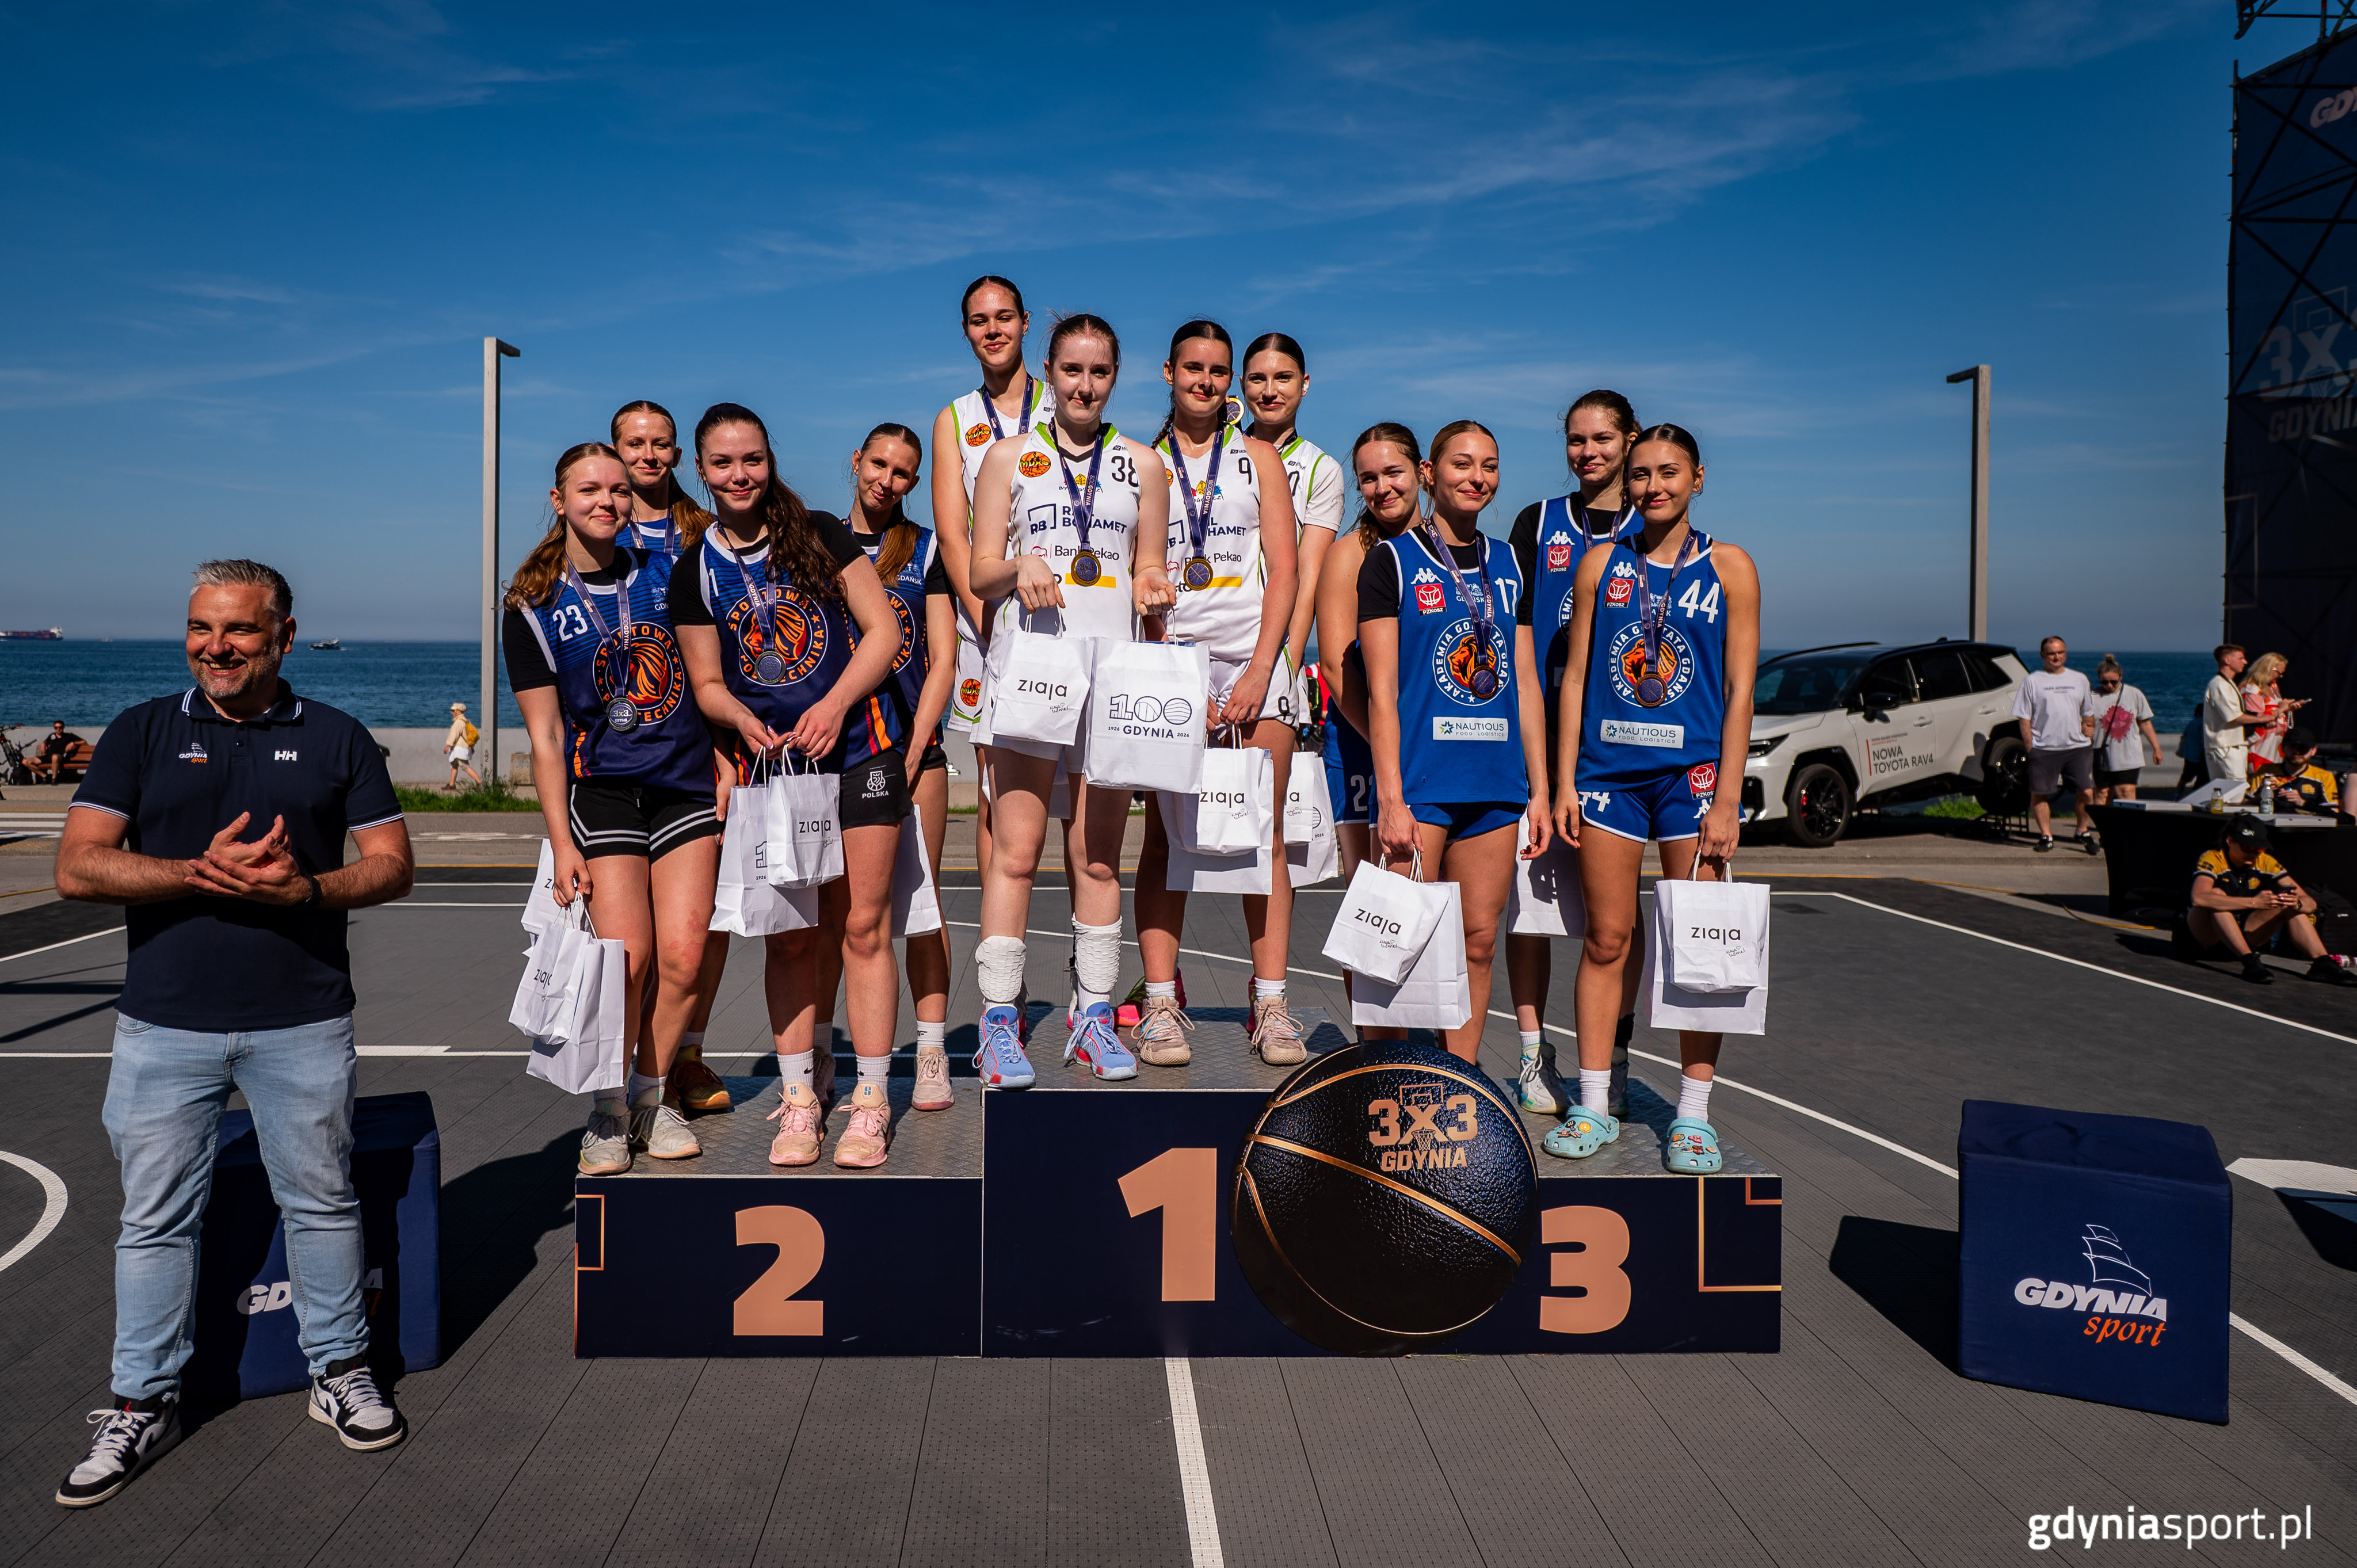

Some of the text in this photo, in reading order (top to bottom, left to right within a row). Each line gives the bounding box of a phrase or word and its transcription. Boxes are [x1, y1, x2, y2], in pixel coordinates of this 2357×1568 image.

[2310, 86, 2357, 128] GD
[1111, 456, 1139, 487] 38
[1238, 457, 1252, 485] 9
[1029, 520, 1047, 535] RB
[1214, 551, 1242, 563] Pekao
[1494, 577, 1518, 617] 17
[1678, 579, 1720, 624] 44
[552, 605, 589, 642] 23
[1436, 633, 1460, 697] AKADEMIA
[1610, 633, 1632, 697] AKADEMIA
[1017, 679, 1067, 700] ziaja
[1109, 693, 1192, 725] 100
[1123, 725, 1174, 739] GDYNIA
[274, 750, 298, 761] HH
[1872, 745, 1903, 761] NOWA
[1874, 753, 1933, 775] TOYOTA RAV4
[861, 790, 889, 799] POLSKA
[1200, 792, 1245, 808] ziaja
[799, 819, 831, 837] ziaja
[1354, 908, 1402, 935] ziaja
[1691, 926, 1741, 945] ziaja
[1369, 1094, 1478, 1147] 3X3
[1381, 1146, 1467, 1173] GDYNIA
[1117, 1147, 1217, 1302] 1
[734, 1205, 825, 1336] 2
[1539, 1205, 1631, 1334] 3
[2015, 1277, 2167, 1322] GDYNIA
[2083, 1316, 2168, 1346] sport
